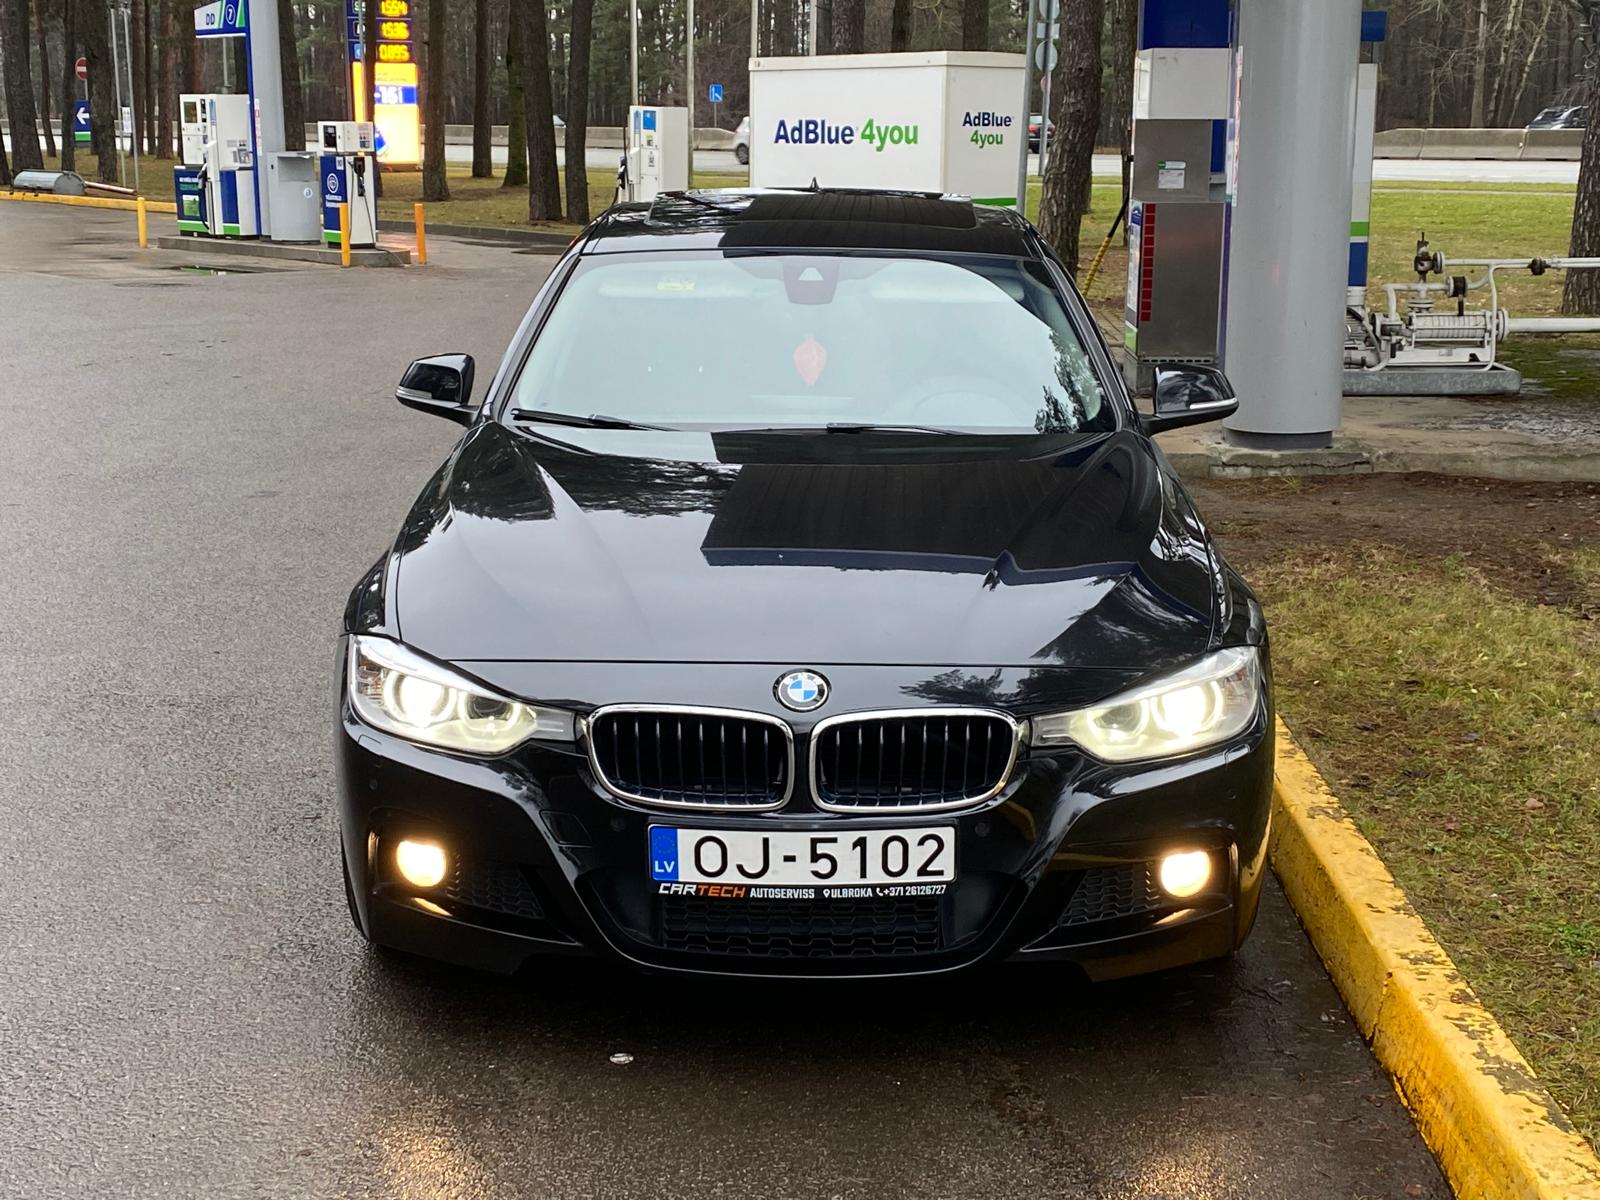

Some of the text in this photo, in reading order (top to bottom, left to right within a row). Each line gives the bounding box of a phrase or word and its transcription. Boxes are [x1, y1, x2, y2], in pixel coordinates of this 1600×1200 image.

[205, 12, 216, 26] DD
[962, 112, 1012, 127] AdBlue
[774, 118, 919, 152] AdBlue 4you
[970, 130, 1004, 148] 4you
[694, 833, 946, 880] OJ-5102
[654, 860, 675, 873] LV
[658, 882, 947, 899] CARTECH AUTOSERVISS ULBROKA +371 26126727
